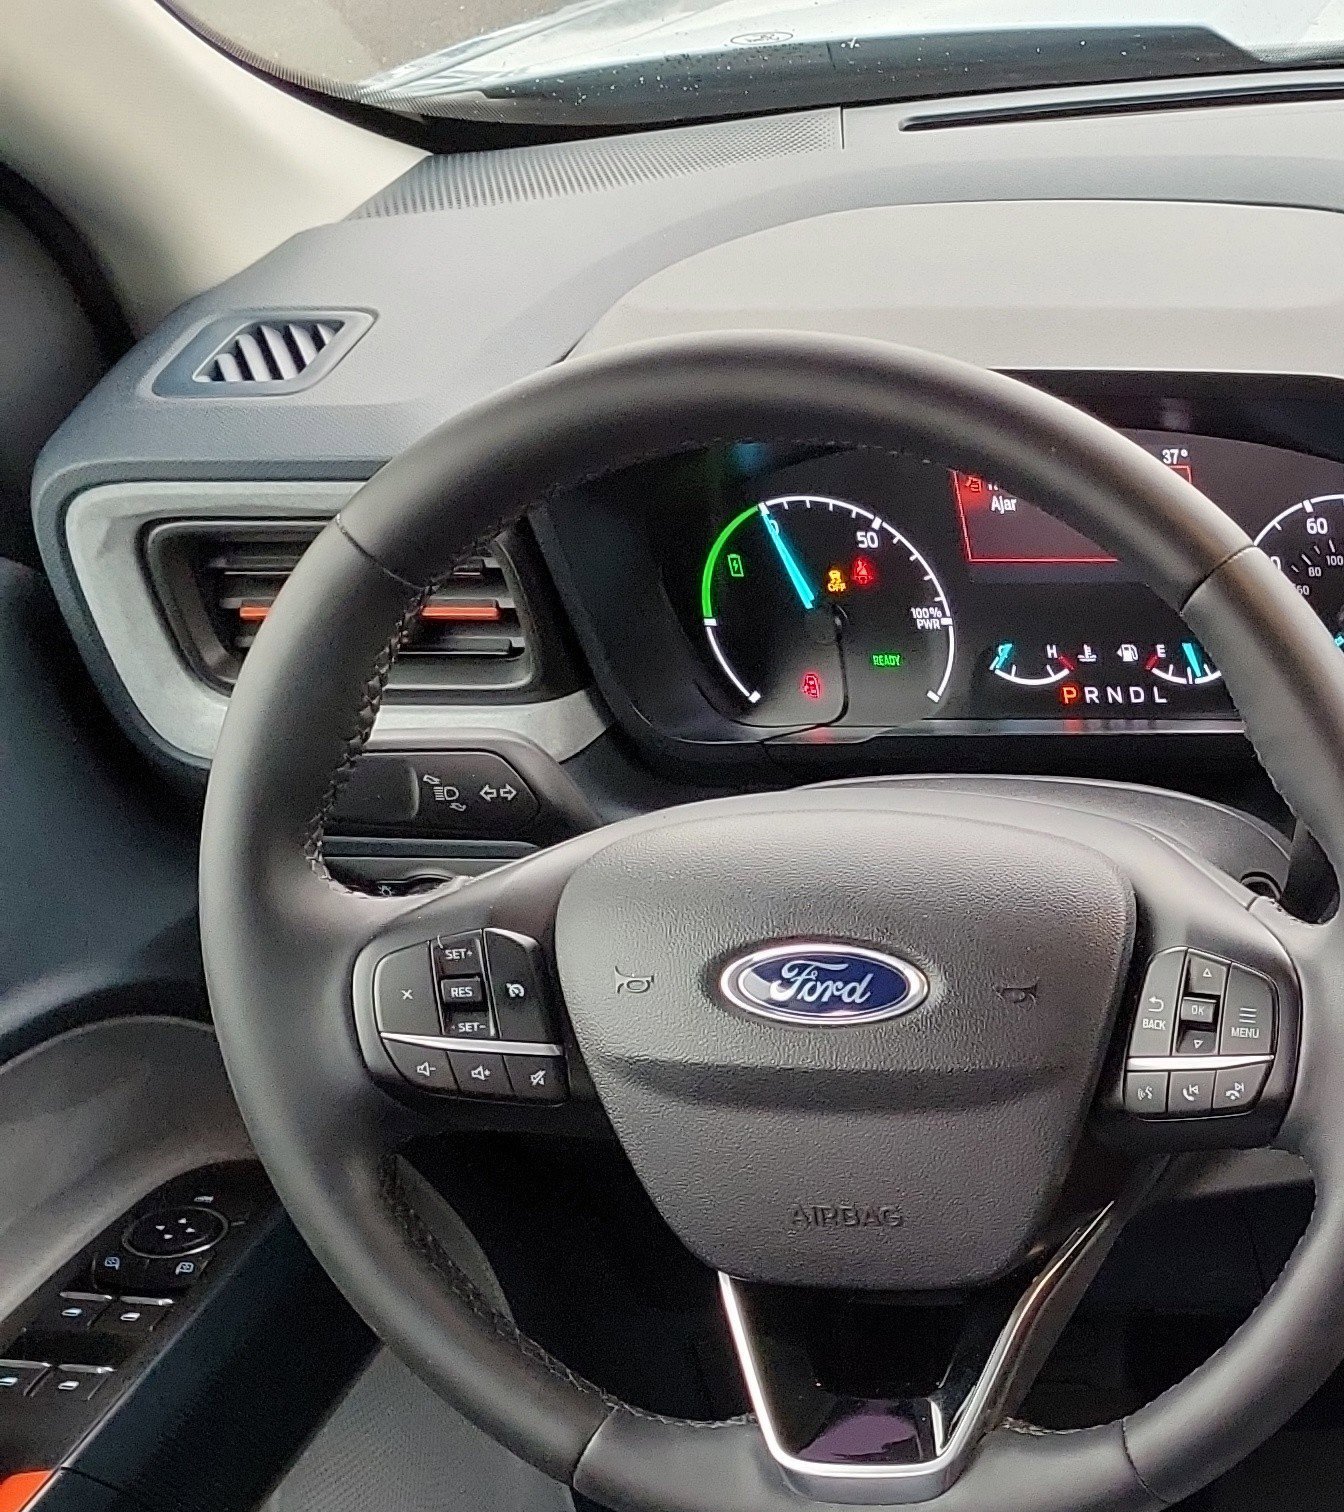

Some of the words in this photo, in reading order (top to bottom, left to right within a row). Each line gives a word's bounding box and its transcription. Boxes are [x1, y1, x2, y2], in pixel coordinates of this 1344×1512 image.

[991, 495, 1018, 515] Ajar
[1306, 517, 1328, 534] 60
[856, 531, 879, 549] 50
[1326, 555, 1344, 566] 100
[1308, 566, 1322, 577] 80
[911, 606, 943, 619] 100%
[916, 618, 942, 630] PWR
[1156, 644, 1167, 658] E
[872, 655, 901, 667] READY
[1063, 686, 1077, 704] P
[1084, 686, 1100, 704] R
[1107, 686, 1123, 704] N
[1129, 686, 1145, 704] D
[1154, 686, 1168, 703] L
[770, 959, 872, 1005] Ford
[450, 986, 473, 999] RES
[1191, 1004, 1205, 1016] OK
[1142, 1018, 1166, 1031] BACK
[1231, 1026, 1260, 1039] MENU
[791, 1205, 902, 1228] AIRBAG
